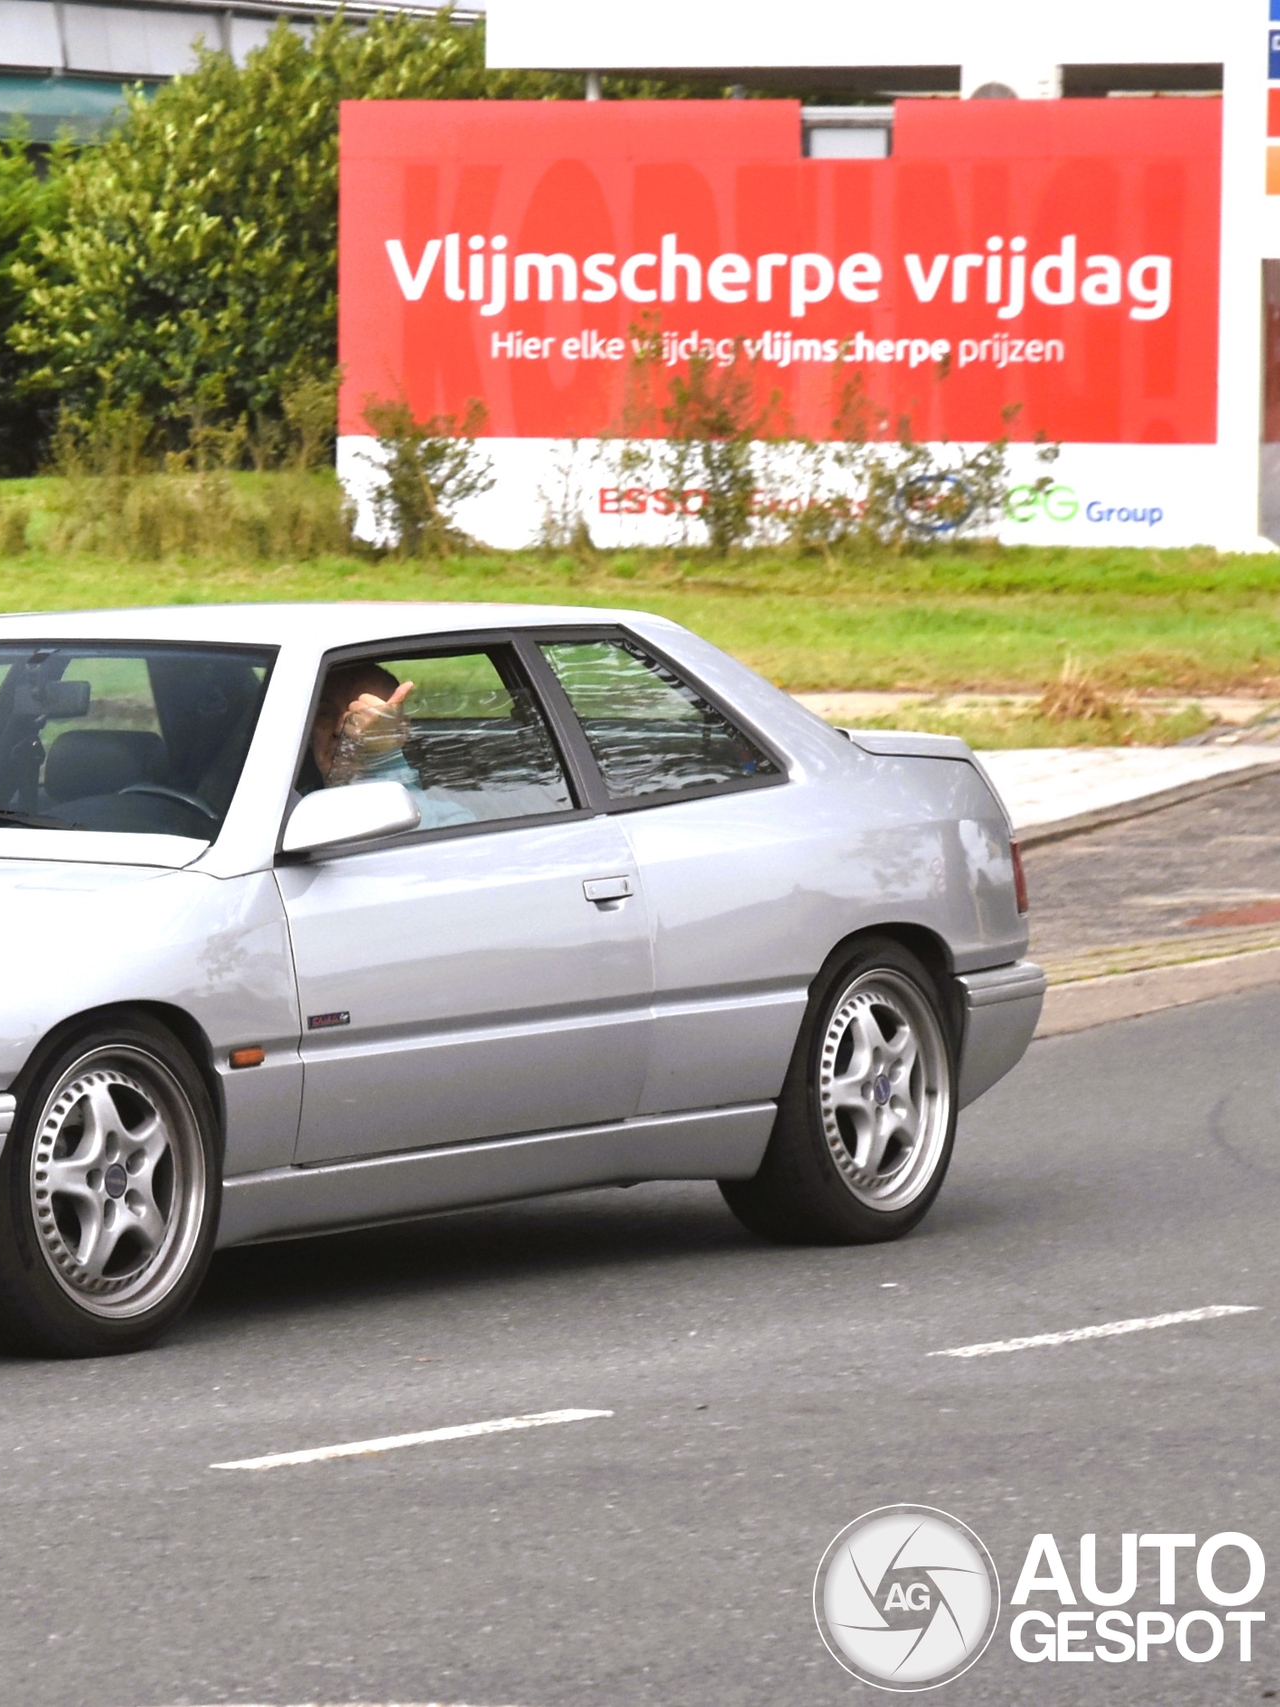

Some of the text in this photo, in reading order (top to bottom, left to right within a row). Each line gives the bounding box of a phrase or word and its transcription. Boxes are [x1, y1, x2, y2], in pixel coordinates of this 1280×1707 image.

[384, 232, 1172, 321] Vlijmscherpe vrijdag
[491, 329, 1065, 368] Hier elke vijdag vlijmscherpe prijzen
[599, 487, 710, 516] ESSO
[1086, 501, 1163, 527] Group
